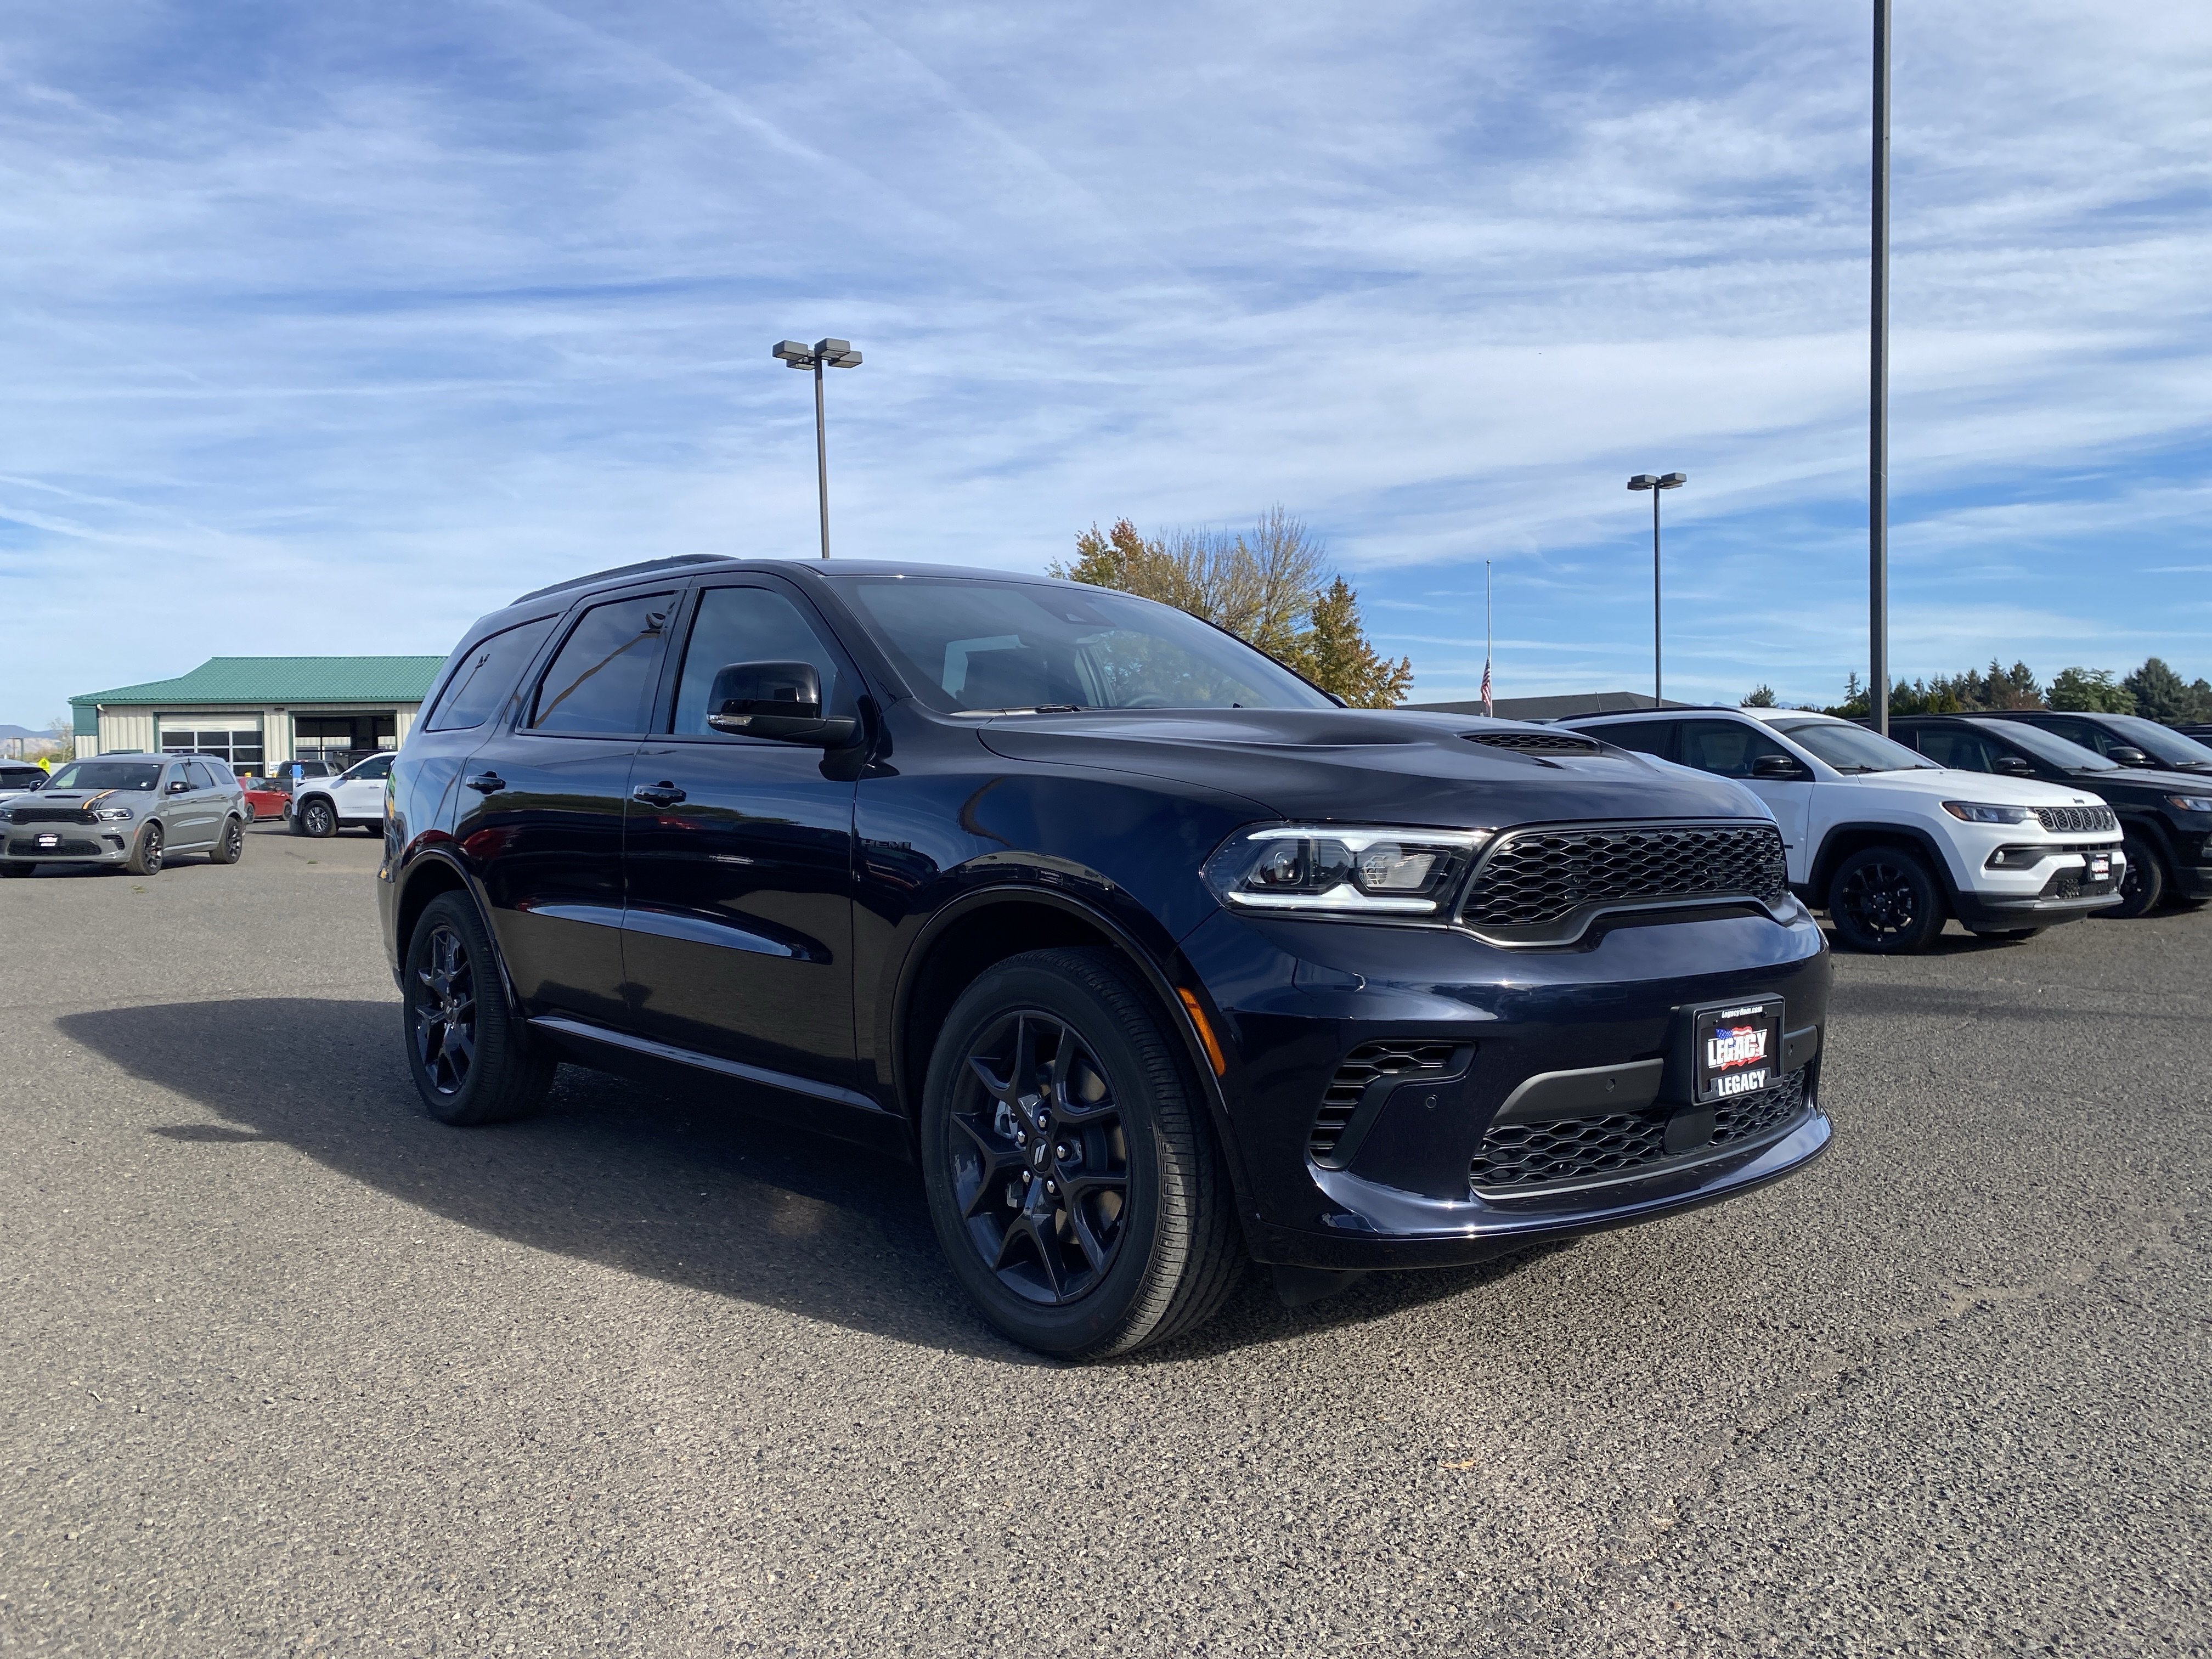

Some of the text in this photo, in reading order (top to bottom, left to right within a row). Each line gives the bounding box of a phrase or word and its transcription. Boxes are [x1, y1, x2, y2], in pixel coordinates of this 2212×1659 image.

[861, 840, 911, 850] HEMI
[1708, 1031, 1767, 1066] LEGACY
[1718, 1070, 1765, 1097] LEGACY
